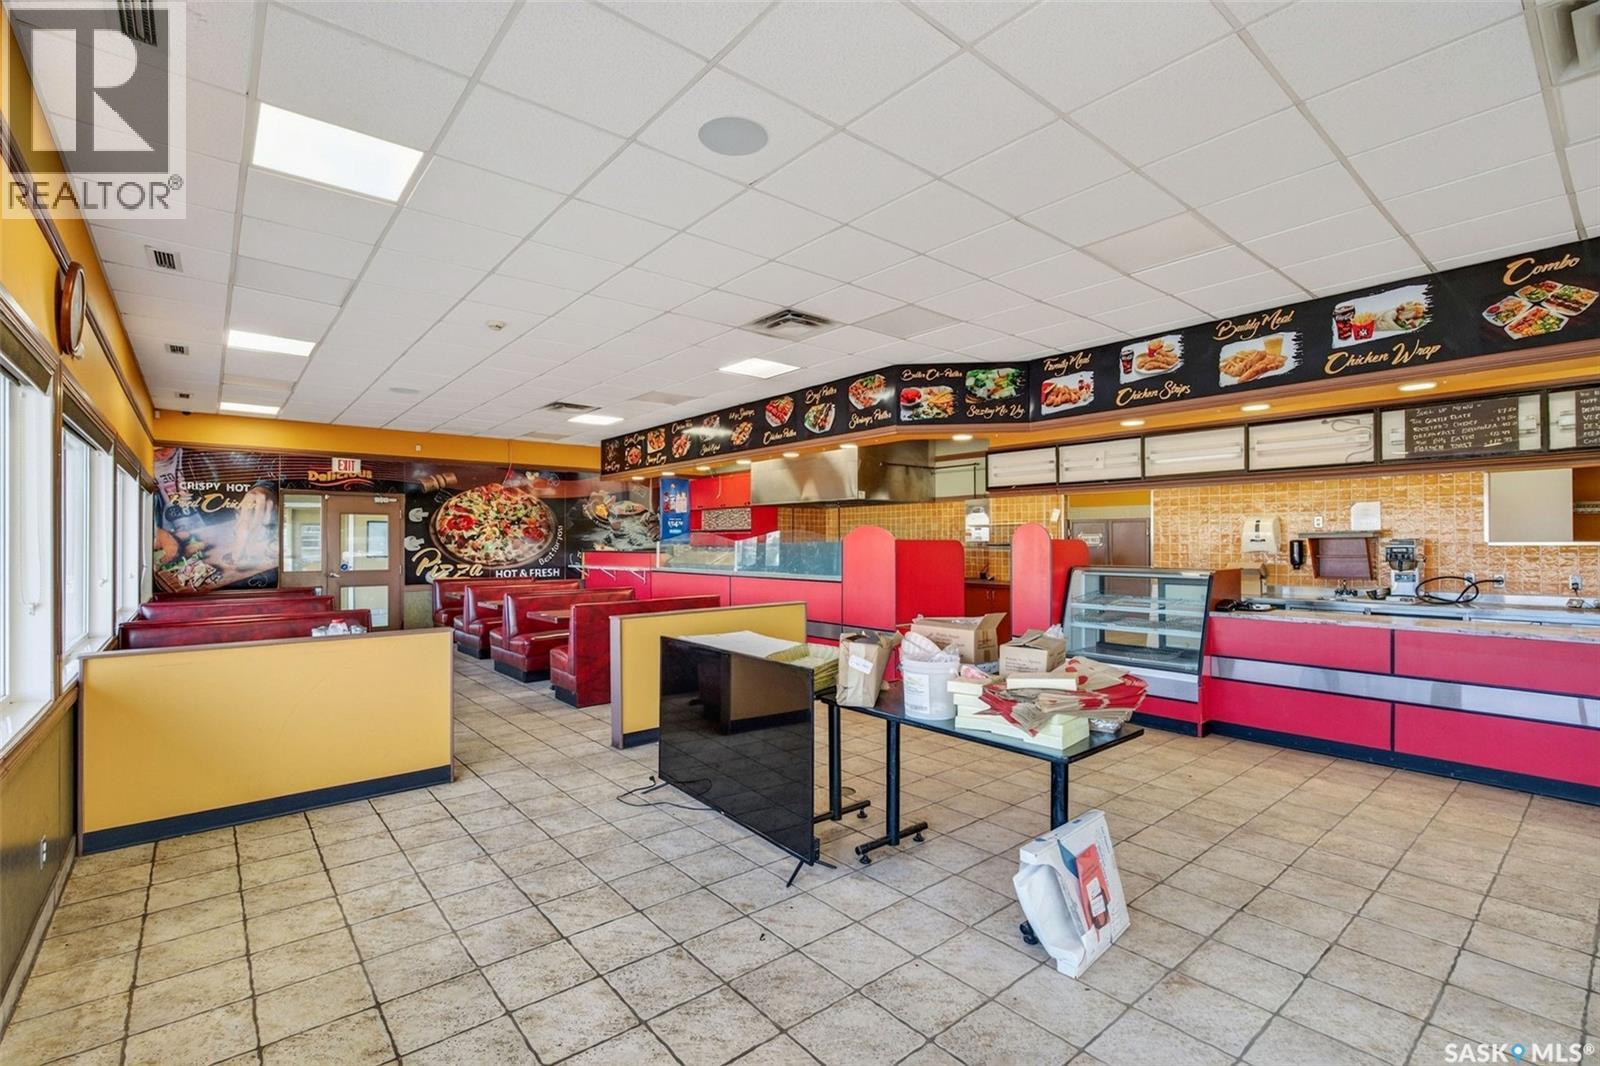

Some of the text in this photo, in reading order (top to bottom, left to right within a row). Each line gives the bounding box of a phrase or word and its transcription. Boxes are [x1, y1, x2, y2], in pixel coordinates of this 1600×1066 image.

[1503, 254, 1580, 286] Combo
[1212, 309, 1295, 341] Buddy Meal
[1324, 338, 1442, 375] Chicken Wrap
[1116, 380, 1192, 407] Chicken Strips
[338, 460, 355, 471] EXIT
[179, 481, 251, 493] CRISPY HOT
[411, 548, 483, 579] Pizza
[495, 568, 560, 579] HOT & FRESH
